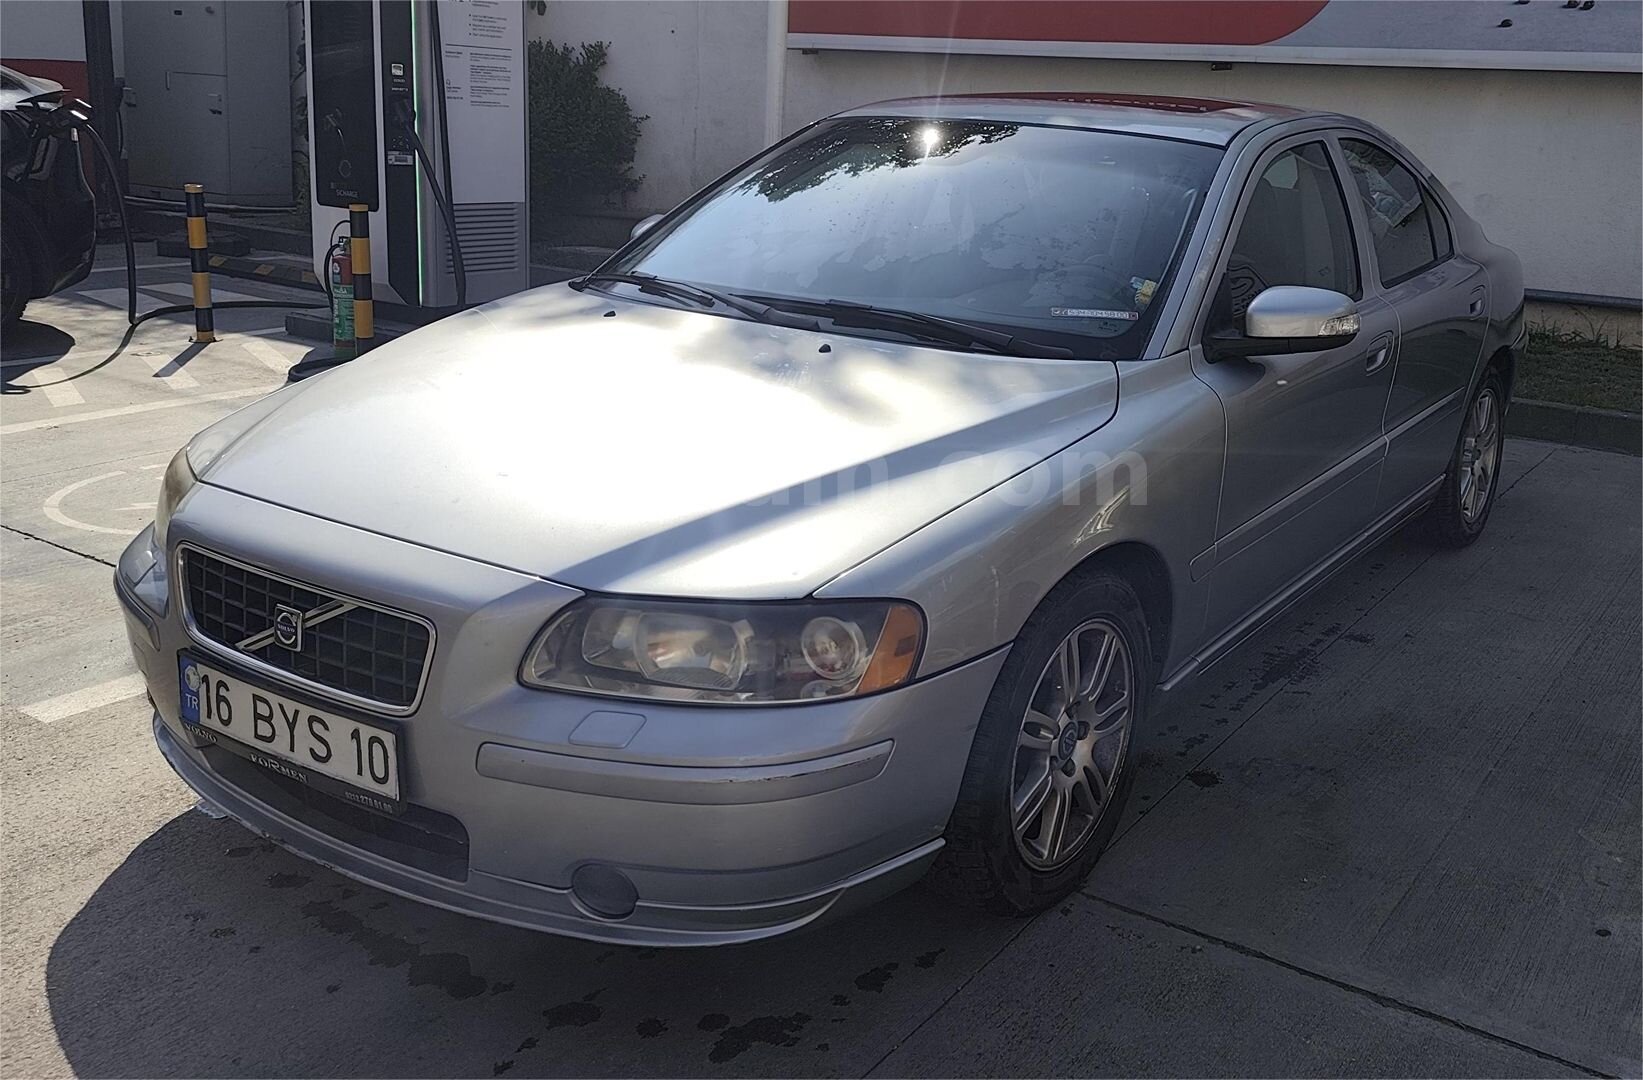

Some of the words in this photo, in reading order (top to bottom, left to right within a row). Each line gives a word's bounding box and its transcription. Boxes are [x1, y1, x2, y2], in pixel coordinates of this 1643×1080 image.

[185, 694, 199, 710] TR
[201, 674, 233, 727] 16
[252, 693, 333, 764] BYS
[351, 727, 390, 785] 10
